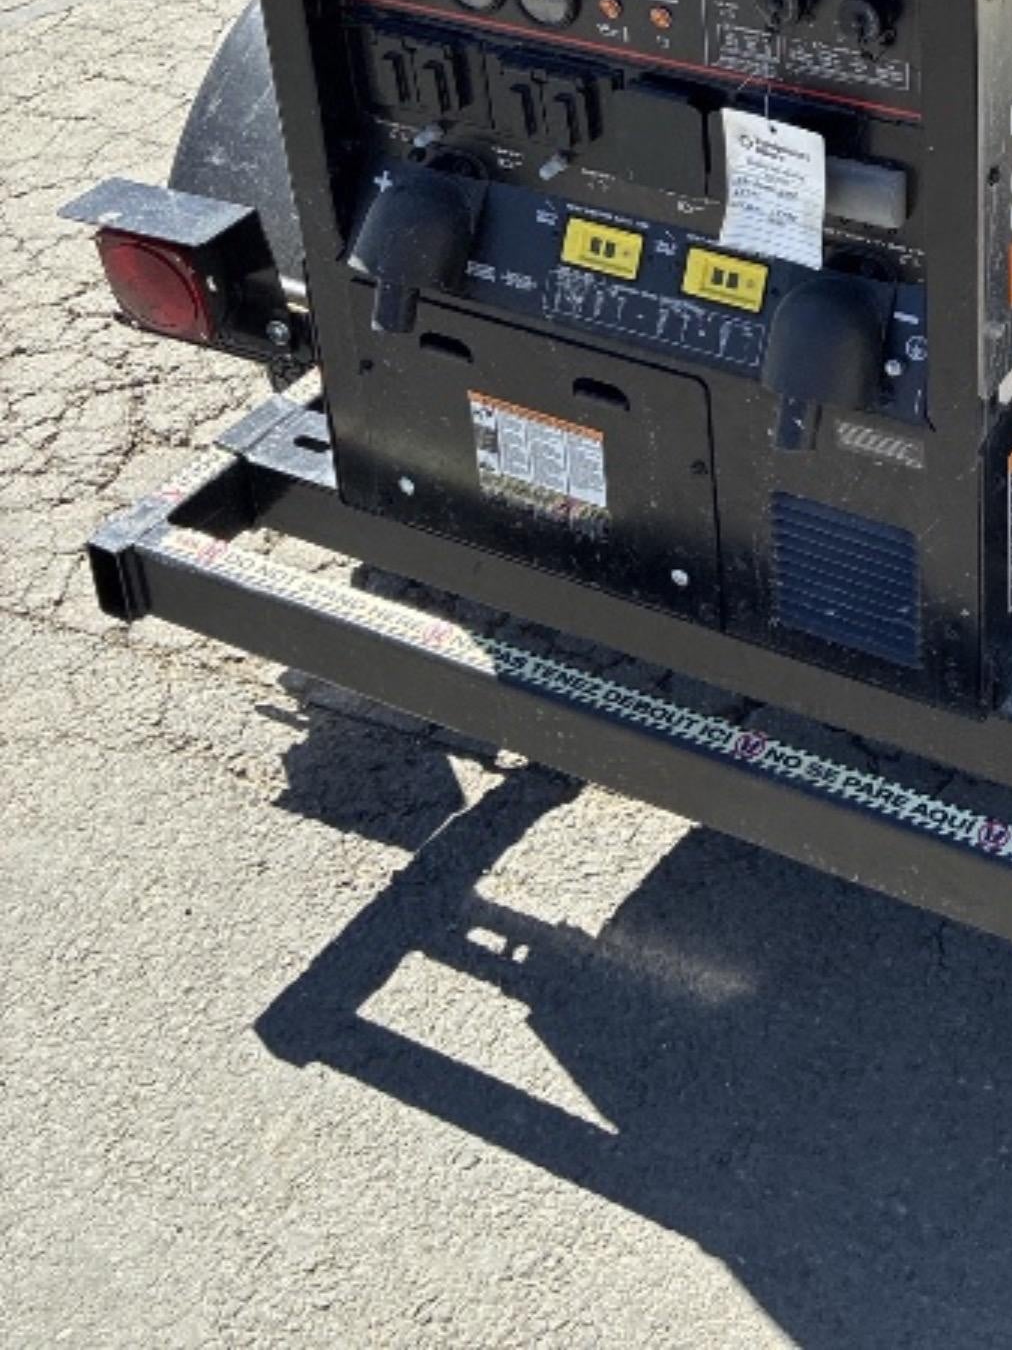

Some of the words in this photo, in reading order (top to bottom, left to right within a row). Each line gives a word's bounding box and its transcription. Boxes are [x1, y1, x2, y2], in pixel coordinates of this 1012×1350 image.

[602, 688, 700, 728] DEBOUT
[702, 723, 733, 744] ICI
[764, 747, 801, 769] NO
[806, 759, 840, 784] SE
[842, 775, 907, 809] PARE
